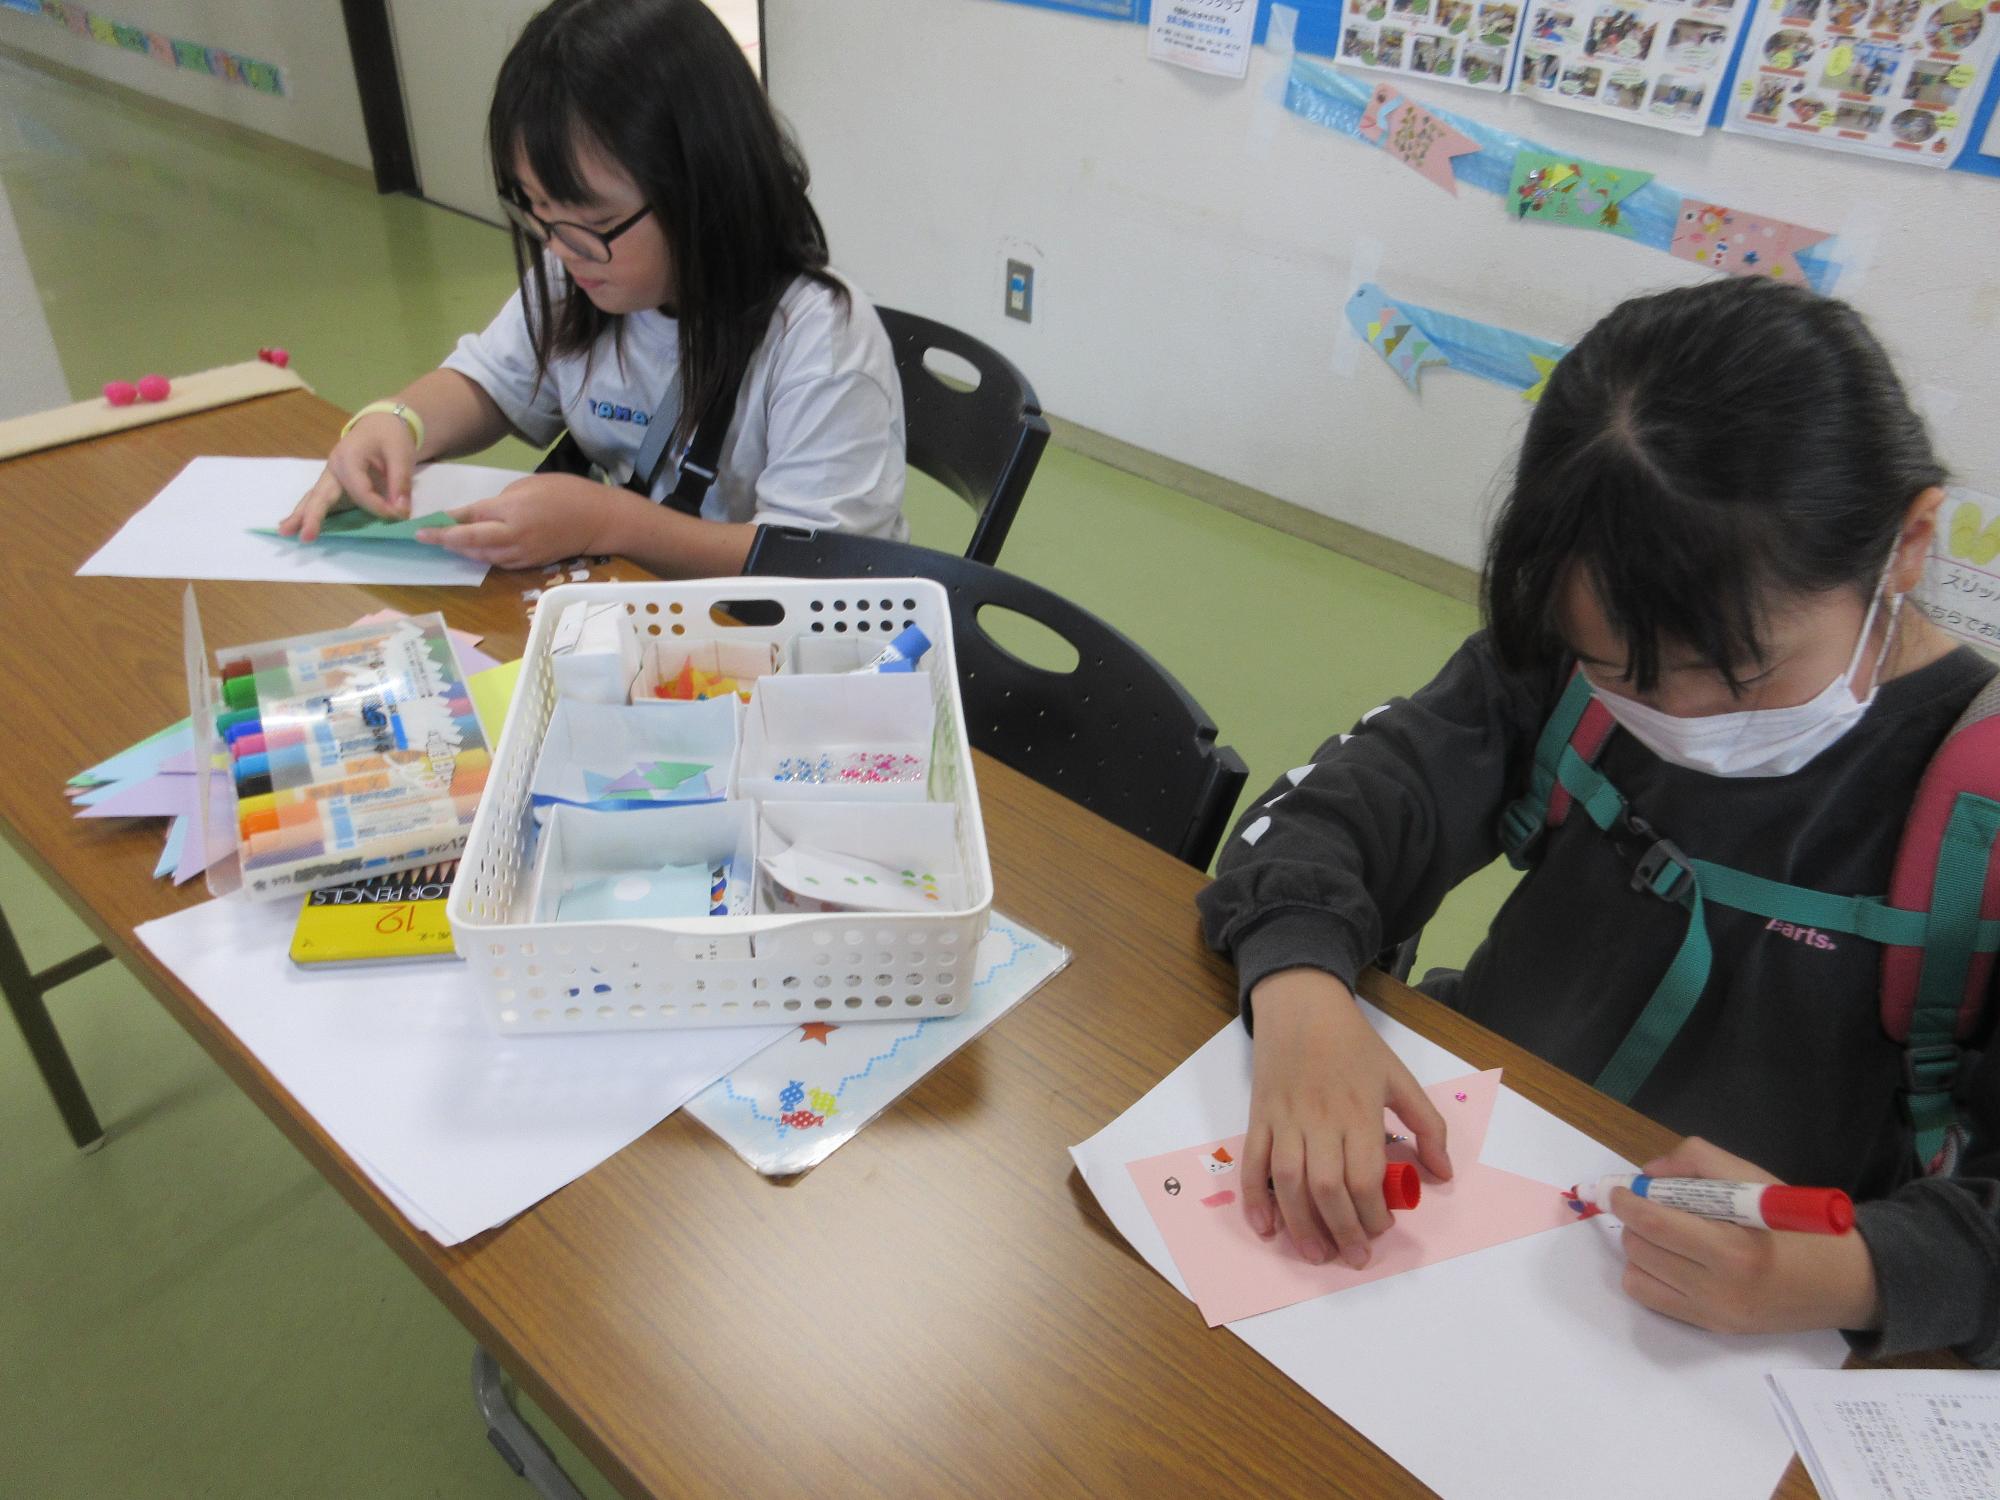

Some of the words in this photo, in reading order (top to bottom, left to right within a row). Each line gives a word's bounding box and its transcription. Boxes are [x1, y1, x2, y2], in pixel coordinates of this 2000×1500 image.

[1941, 573, 2000, 602] スリッ
[1923, 602, 2000, 640] ちらでお
[313, 885, 404, 905] PENCILS
[375, 904, 416, 934] 12
